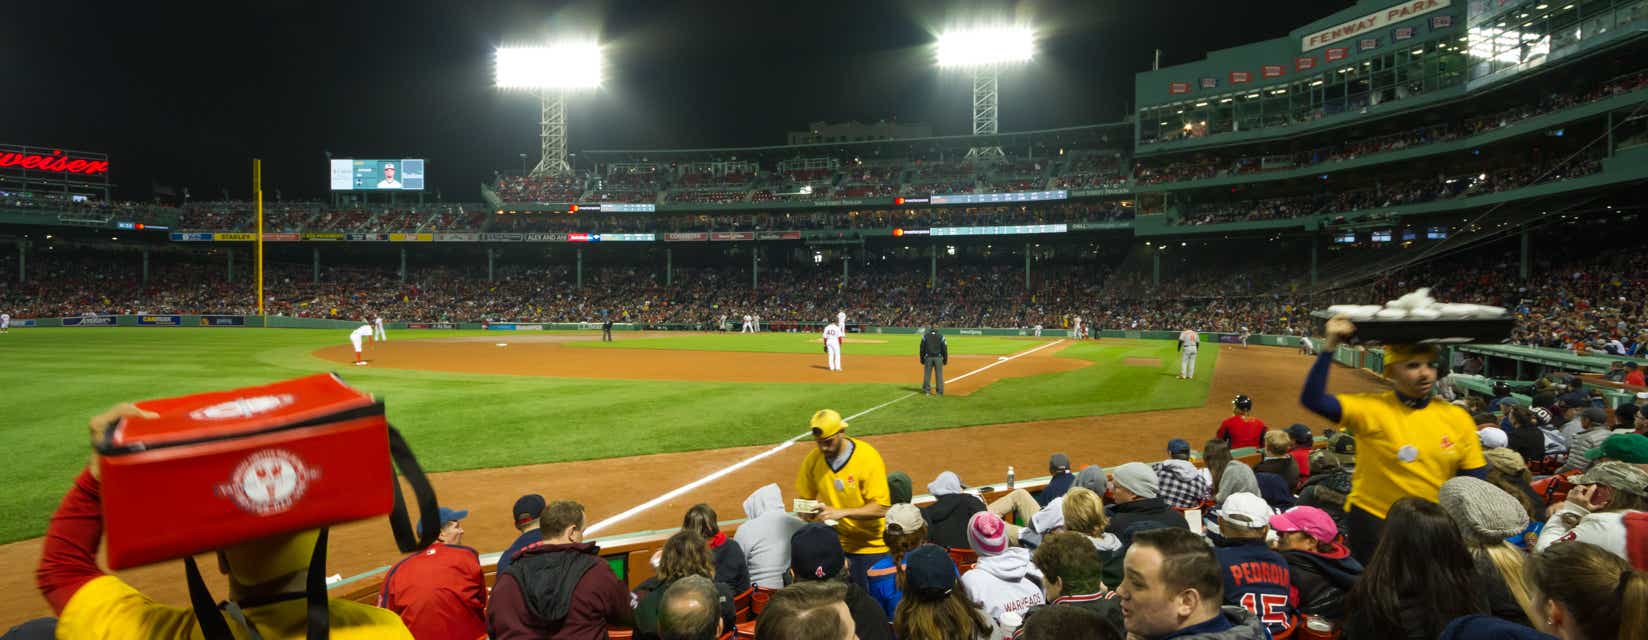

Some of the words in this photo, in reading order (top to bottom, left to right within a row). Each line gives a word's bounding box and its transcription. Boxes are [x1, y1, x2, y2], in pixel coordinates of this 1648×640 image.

[1309, 15, 1378, 47] FENWAY
[1387, 0, 1439, 22] PARK
[1240, 592, 1292, 630] 15
